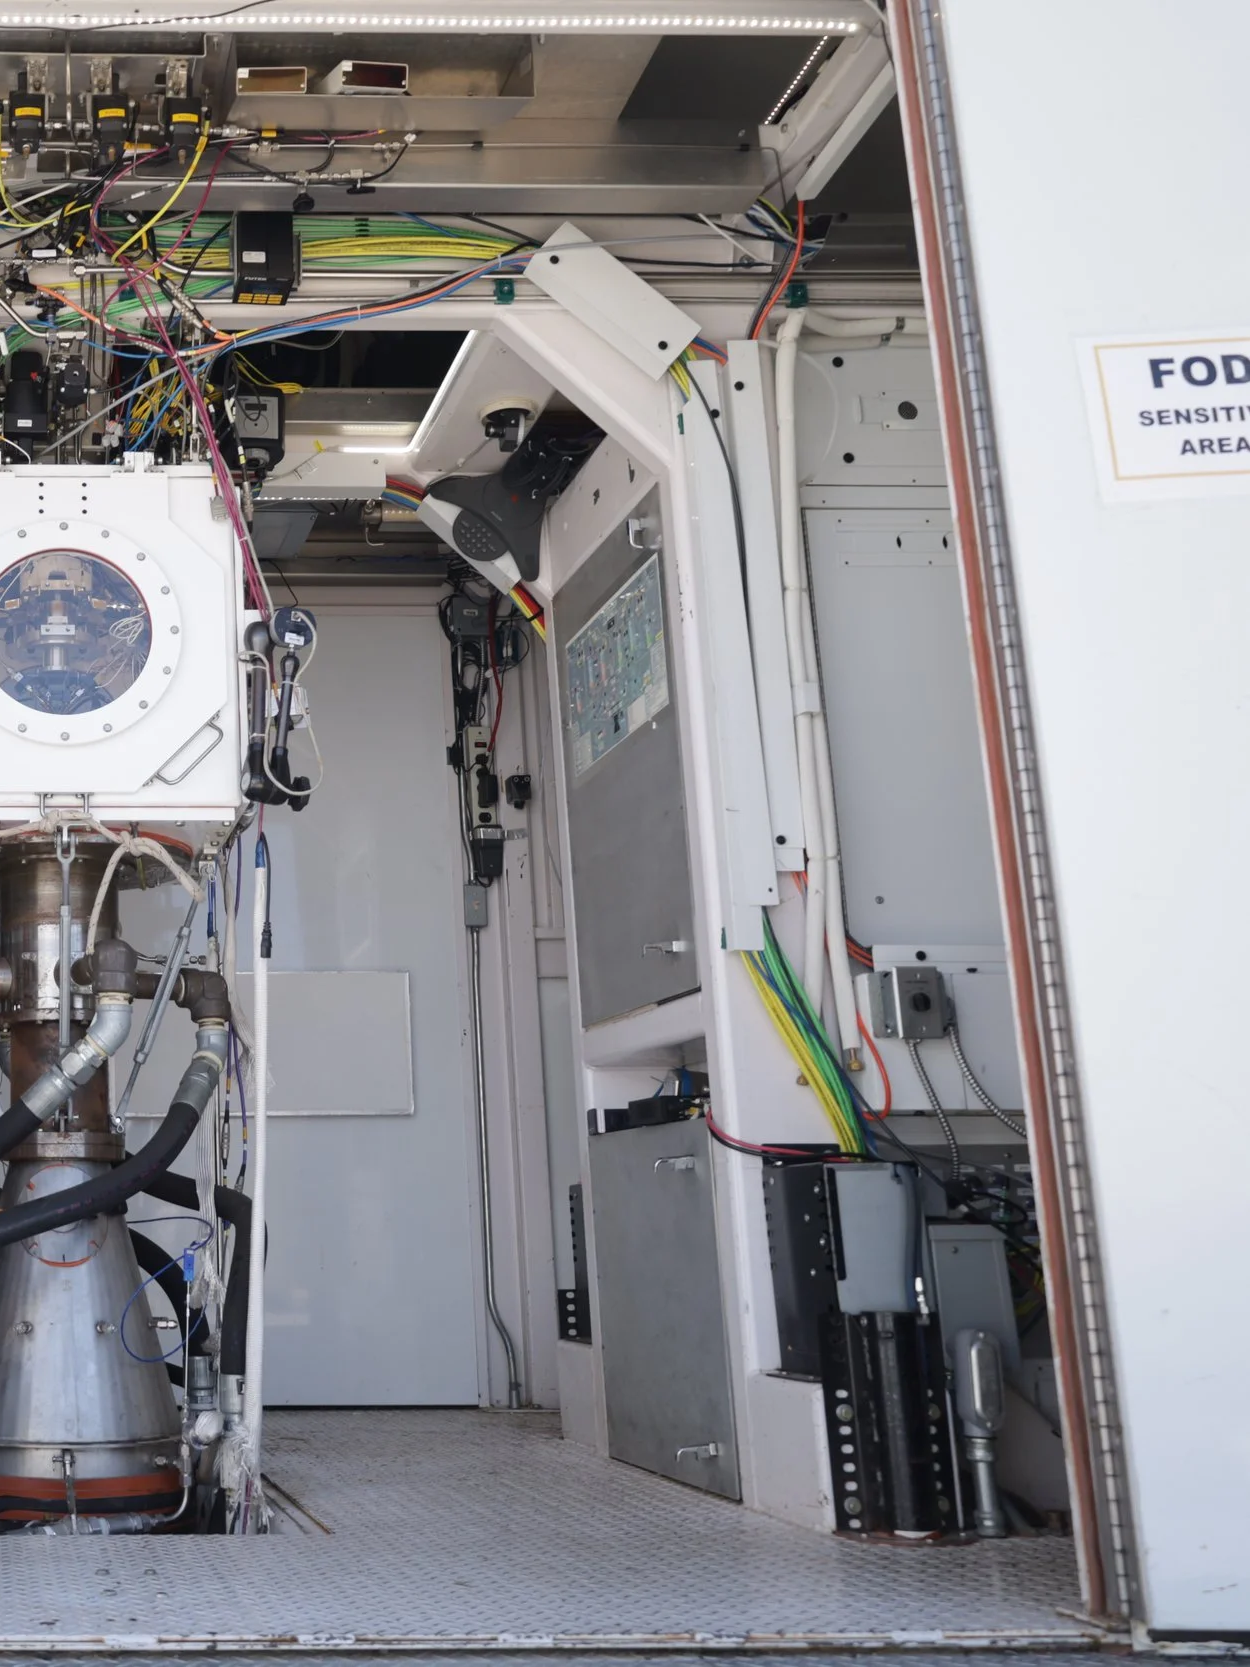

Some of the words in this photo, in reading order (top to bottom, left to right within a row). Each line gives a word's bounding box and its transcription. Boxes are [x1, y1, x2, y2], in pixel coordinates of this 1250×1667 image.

[1148, 354, 1250, 389] FOD
[1138, 405, 1250, 427] SENSITI
[1180, 436, 1250, 455] AREA
